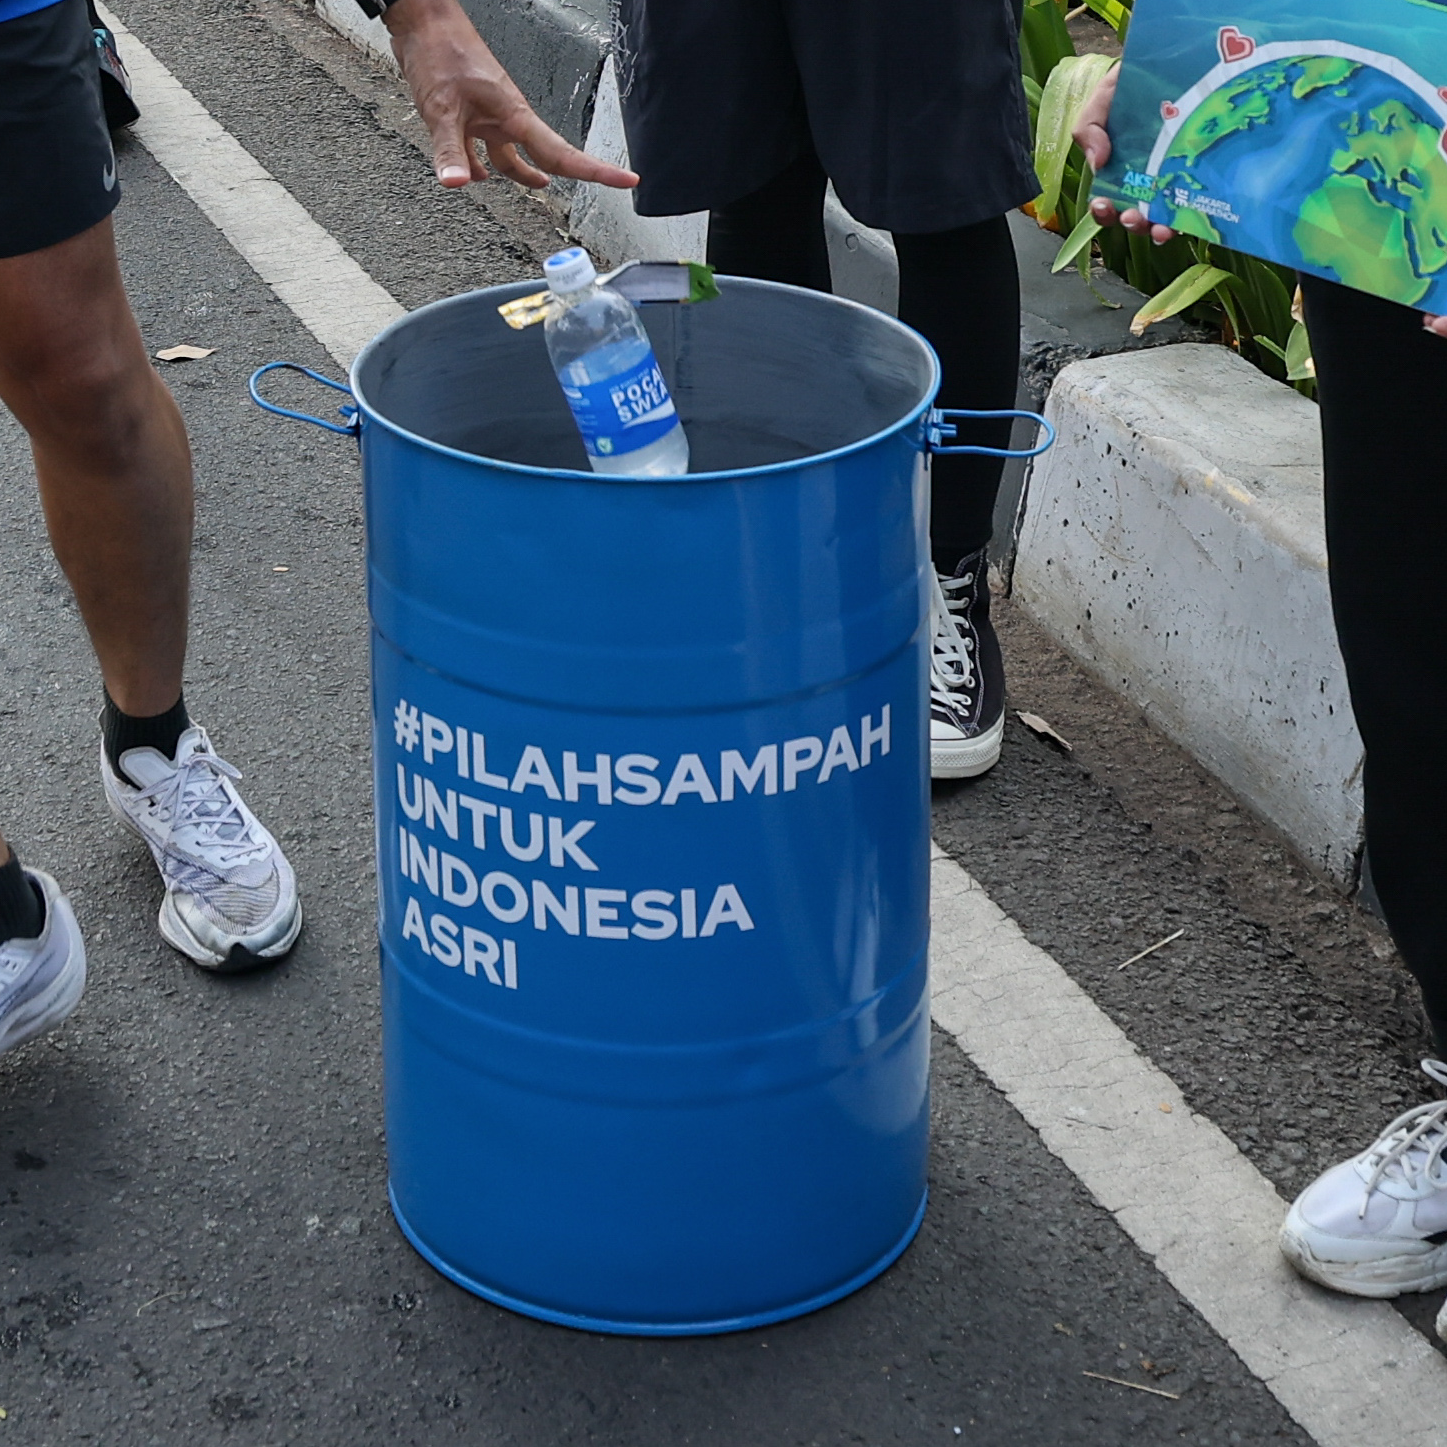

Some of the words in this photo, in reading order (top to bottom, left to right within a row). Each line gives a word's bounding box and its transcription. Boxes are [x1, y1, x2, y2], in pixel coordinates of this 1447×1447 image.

[611, 360, 665, 409] POCA
[616, 383, 671, 423] SWEA
[393, 697, 892, 806] #PILAHSAMPAH
[396, 763, 600, 872] UNTUK
[398, 825, 756, 941] INDONESIA
[401, 895, 519, 990] ASRI
